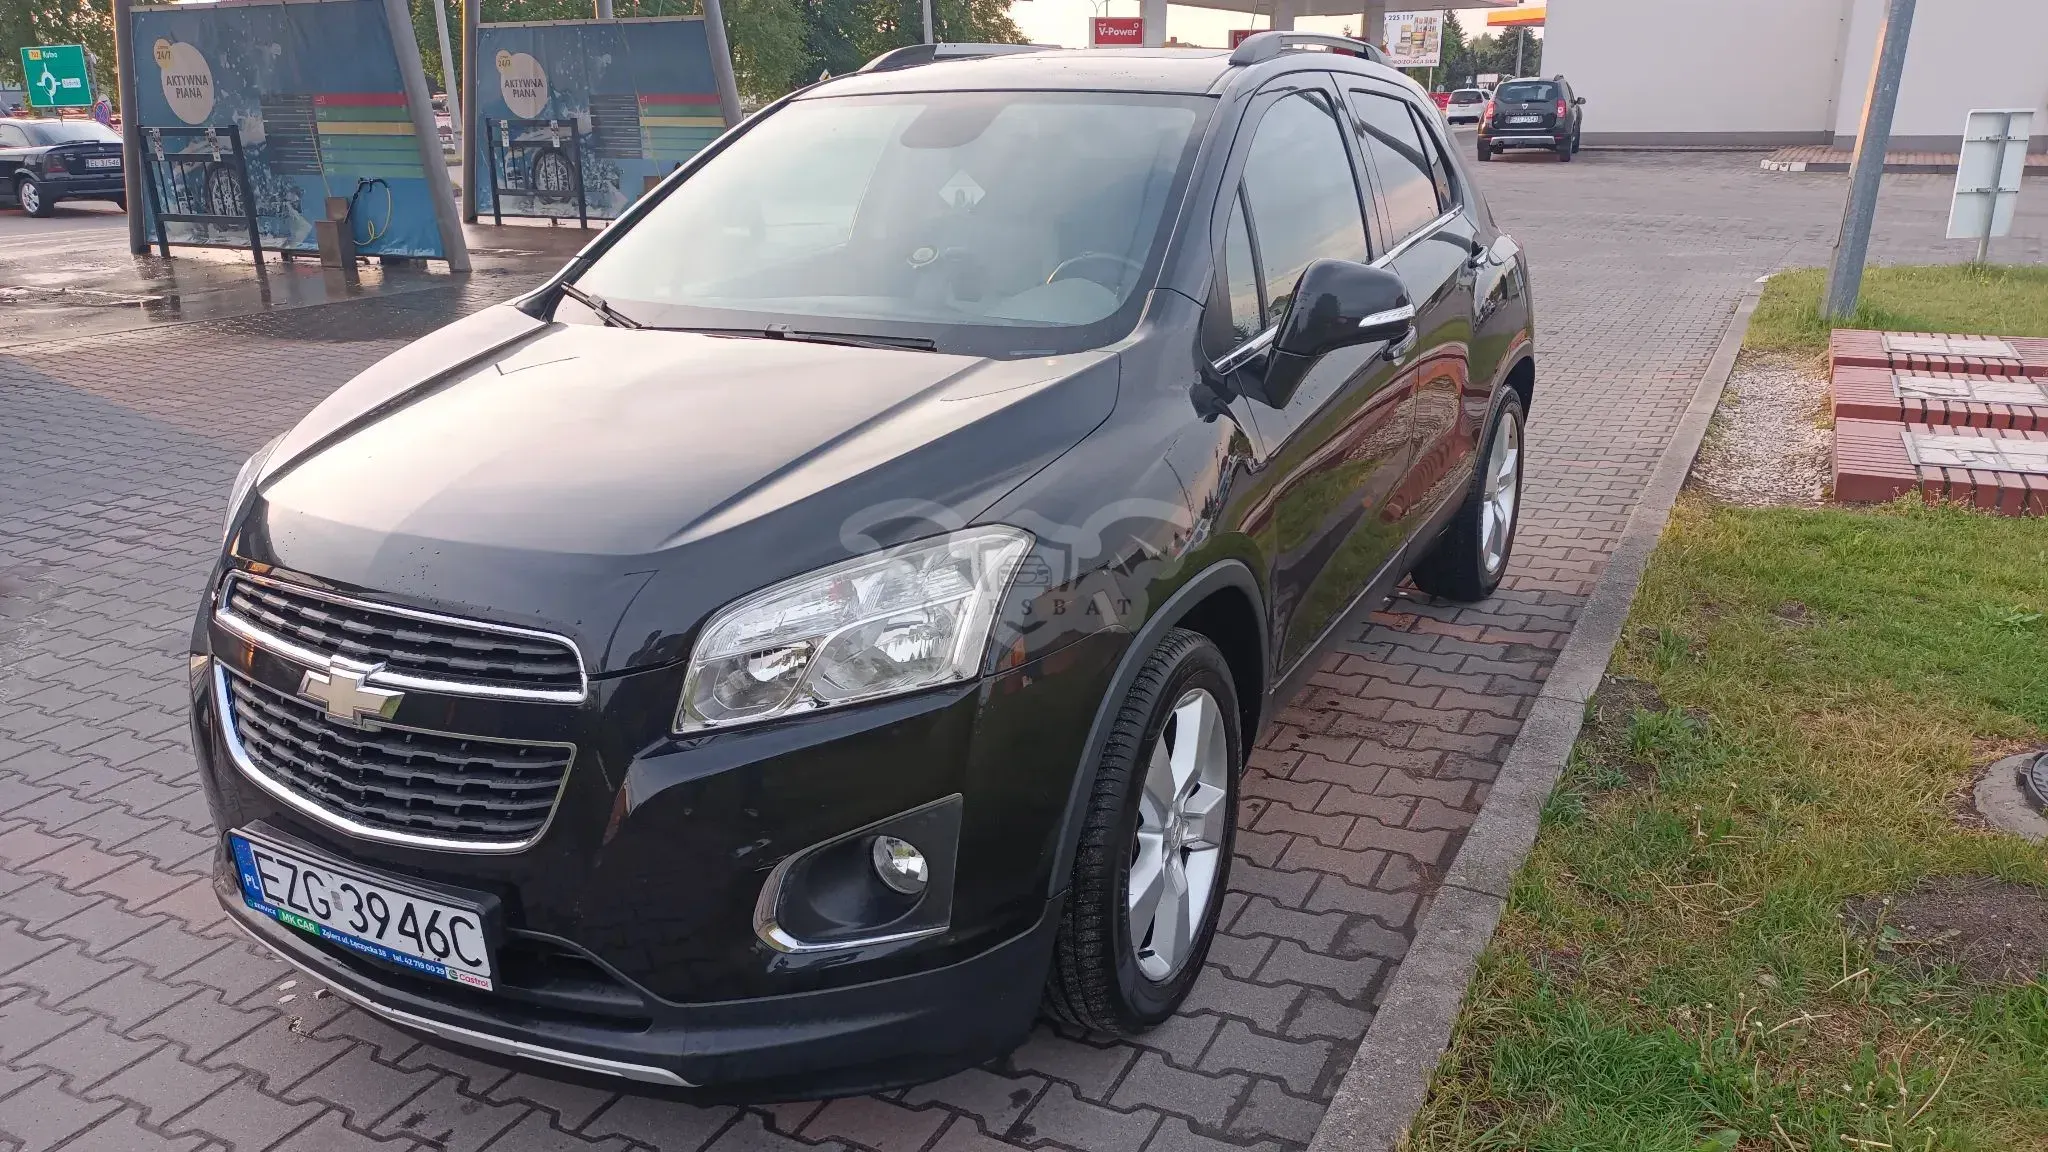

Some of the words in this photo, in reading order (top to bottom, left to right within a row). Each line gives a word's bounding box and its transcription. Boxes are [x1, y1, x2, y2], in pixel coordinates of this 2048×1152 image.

[1098, 27, 1137, 36] V-Power
[156, 51, 171, 60] 24/7
[166, 75, 209, 86] AKTYWNA
[504, 79, 543, 88] AKTYWNA
[176, 87, 203, 98] PIANA
[512, 89, 537, 98] PIANA
[244, 873, 260, 890] PL
[253, 850, 331, 920] EZG
[340, 882, 483, 968] 3946C
[281, 912, 298, 926] MK
[297, 919, 316, 933] CAR
[404, 958, 414, 967] 42
[413, 960, 424, 969] 719
[425, 964, 436, 973] 00
[459, 973, 489, 988] Castrol
